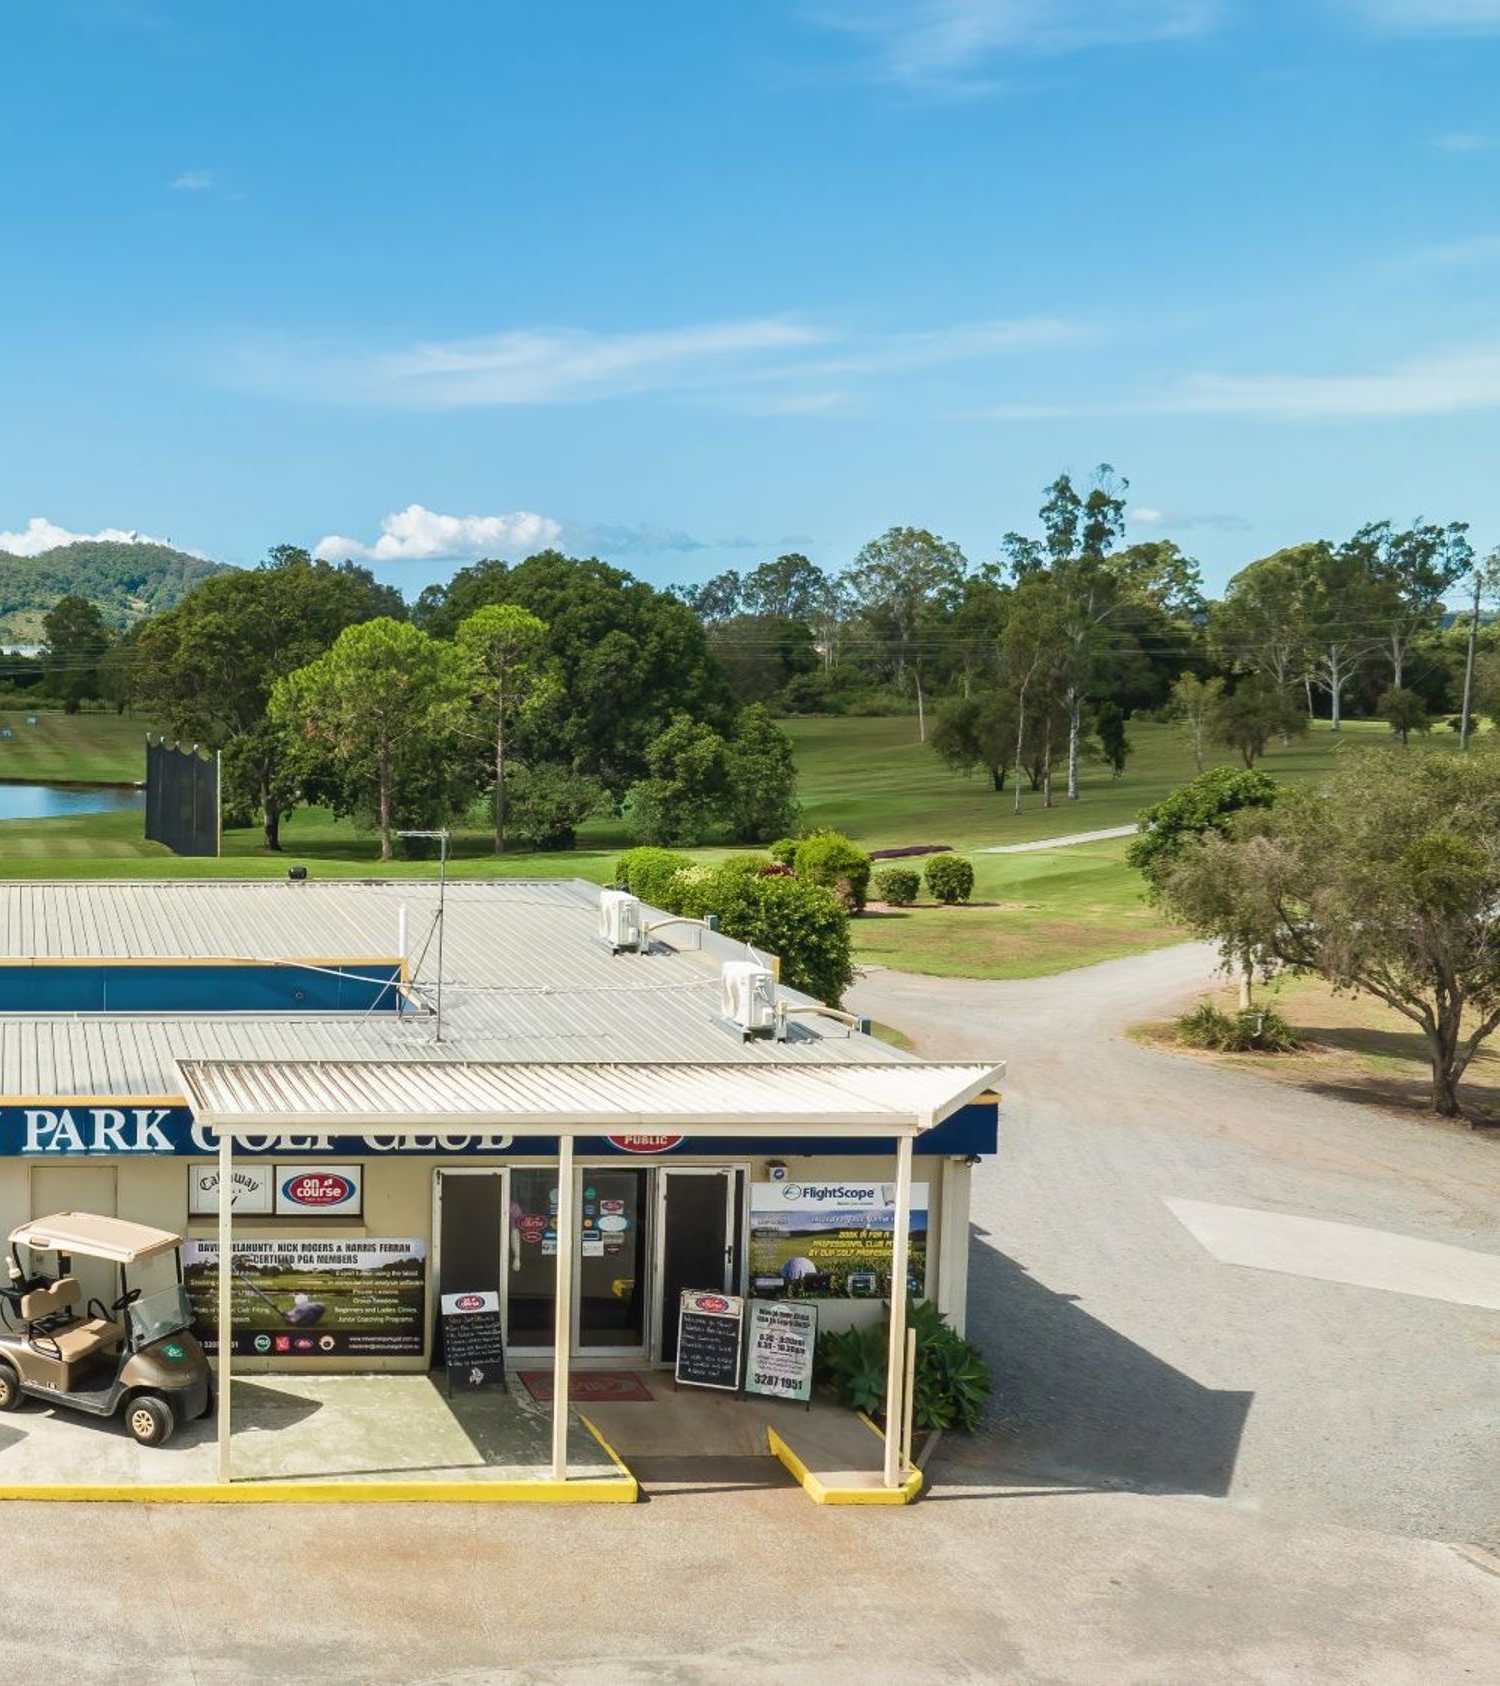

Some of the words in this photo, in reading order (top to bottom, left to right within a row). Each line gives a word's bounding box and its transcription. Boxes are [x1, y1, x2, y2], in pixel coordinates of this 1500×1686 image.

[22, 1108, 175, 1151] PARK
[624, 1134, 668, 1145] PUBLIC
[200, 1171, 259, 1192] Calway
[303, 1178, 319, 1188] on
[296, 1186, 342, 1197] course
[803, 1186, 875, 1200] FlightScope
[198, 1243, 220, 1253] DAVI
[230, 1243, 276, 1253] ELAHUNTY,
[277, 1243, 299, 1253] NICK
[301, 1243, 334, 1253] ROGERS
[345, 1243, 377, 1253] HARRIS
[379, 1243, 411, 1253] FERRAN
[865, 1240, 883, 1248] CLUB
[253, 1254, 296, 1264] CERTIFIED
[297, 1254, 315, 1264] PGA
[316, 1254, 358, 1264] MEMBERS
[754, 1373, 780, 1387] 3287
[781, 1377, 804, 1390] 1951
